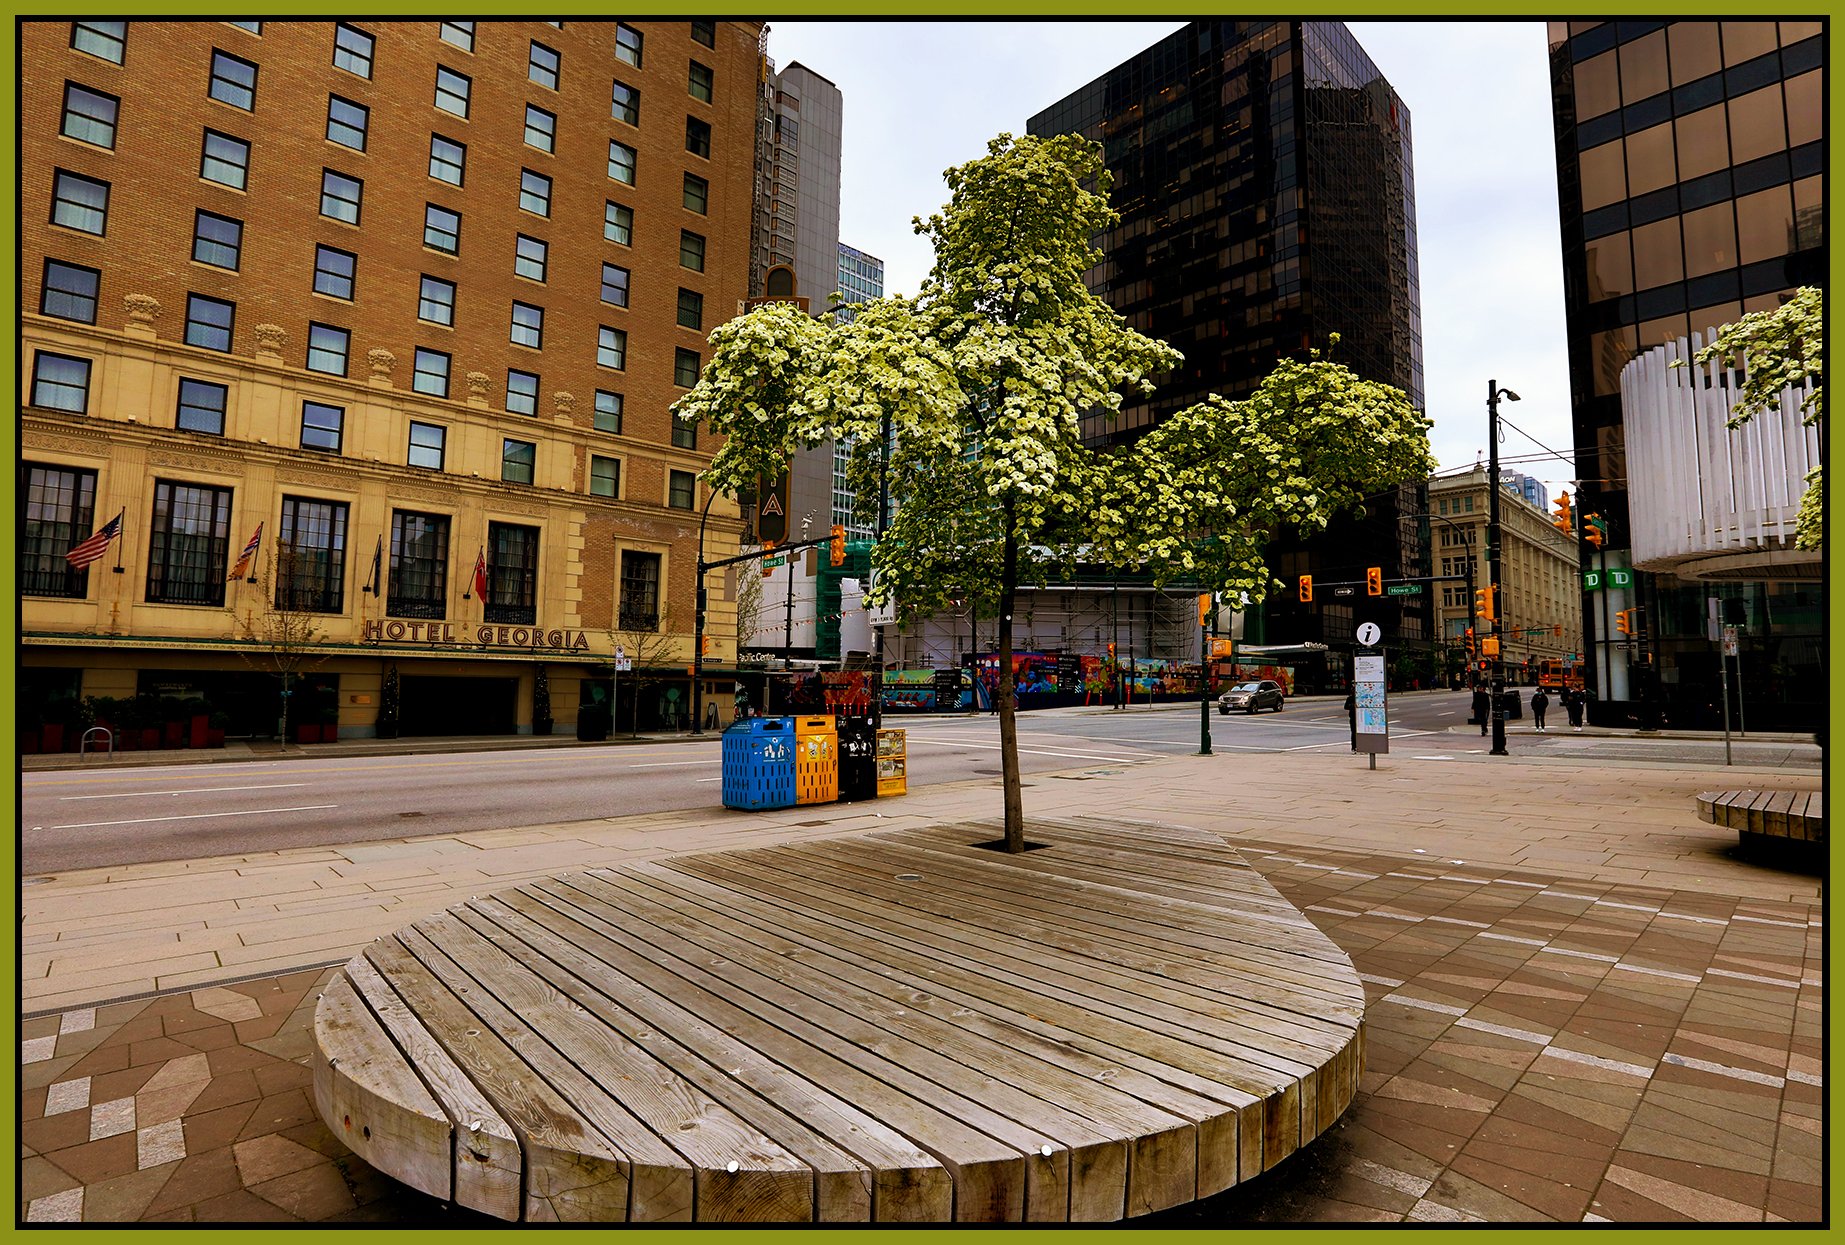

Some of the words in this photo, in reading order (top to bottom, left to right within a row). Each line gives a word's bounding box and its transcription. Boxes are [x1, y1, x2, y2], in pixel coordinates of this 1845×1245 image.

[1585, 573, 1599, 587] TD
[1611, 571, 1629, 585] TD
[365, 619, 456, 642] HOTEL
[477, 626, 589, 648] GEORGIA
[756, 653, 776, 662] Centre
